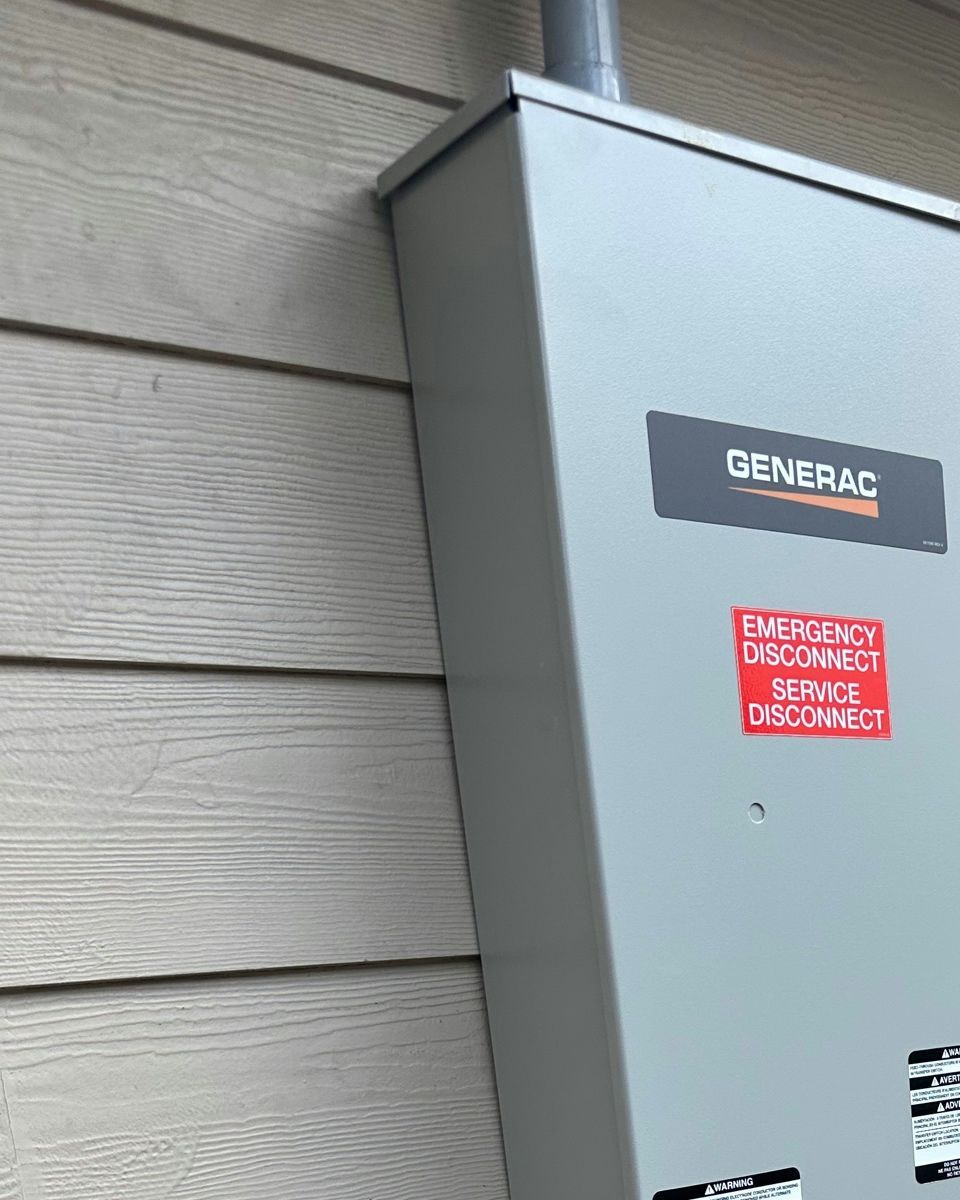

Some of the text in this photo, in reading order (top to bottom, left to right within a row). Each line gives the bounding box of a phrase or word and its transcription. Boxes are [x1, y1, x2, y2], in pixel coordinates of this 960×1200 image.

[727, 449, 877, 498] GENERAC
[743, 615, 876, 647] EMERGENCY
[743, 641, 880, 672] DISCONNECT
[772, 678, 861, 704] SERVICE
[749, 703, 884, 731] DISCONNECT
[714, 1178, 753, 1192] WARNING
